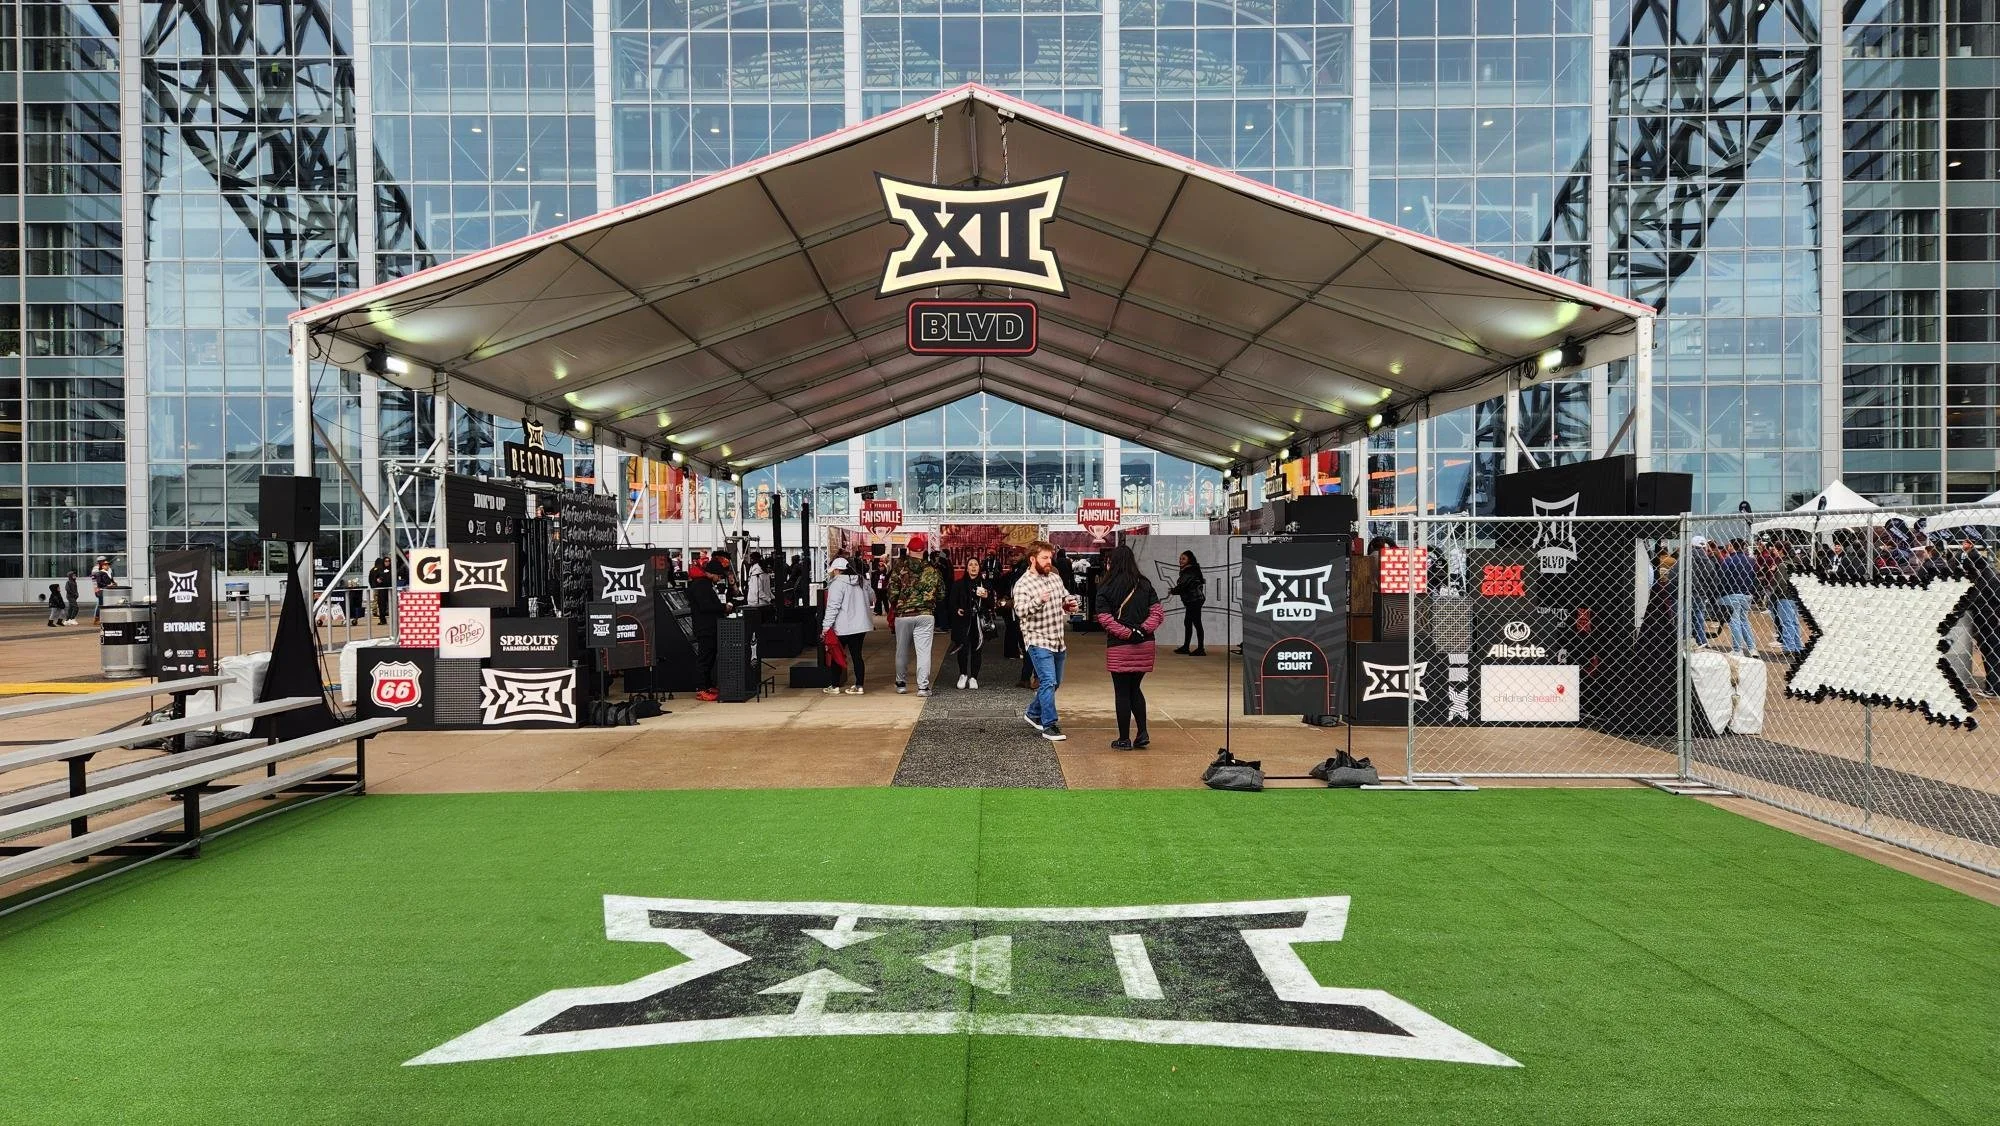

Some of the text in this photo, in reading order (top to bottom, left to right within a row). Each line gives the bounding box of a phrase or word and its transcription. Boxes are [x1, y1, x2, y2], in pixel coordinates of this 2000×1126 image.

[894, 189, 1051, 280] XII
[921, 312, 1024, 342] BLVD
[511, 448, 563, 479] RECORDS
[496, 497, 506, 511] UP
[1079, 509, 1119, 522] FANSVILLE
[416, 556, 442, 585] G
[457, 563, 504, 588] XII
[1482, 565, 1525, 581] SEAT
[170, 574, 196, 594] XII
[604, 569, 643, 595] XII
[1262, 571, 1327, 606] XII
[1481, 580, 1526, 597] GEEK
[614, 594, 635, 602] BLVD
[1277, 608, 1312, 617] BLVD
[163, 622, 206, 632] ENTRANCE
[445, 625, 482, 645] Pepper
[459, 623, 473, 634] Dr
[500, 635, 559, 646] SPROUTS
[1277, 652, 1312, 660] SPORT
[378, 669, 413, 677] PHILLIPS
[1277, 662, 1312, 670] COURT
[1368, 667, 1422, 695] XI
[380, 681, 412, 700] 66
[516, 907, 1418, 1039] XII
